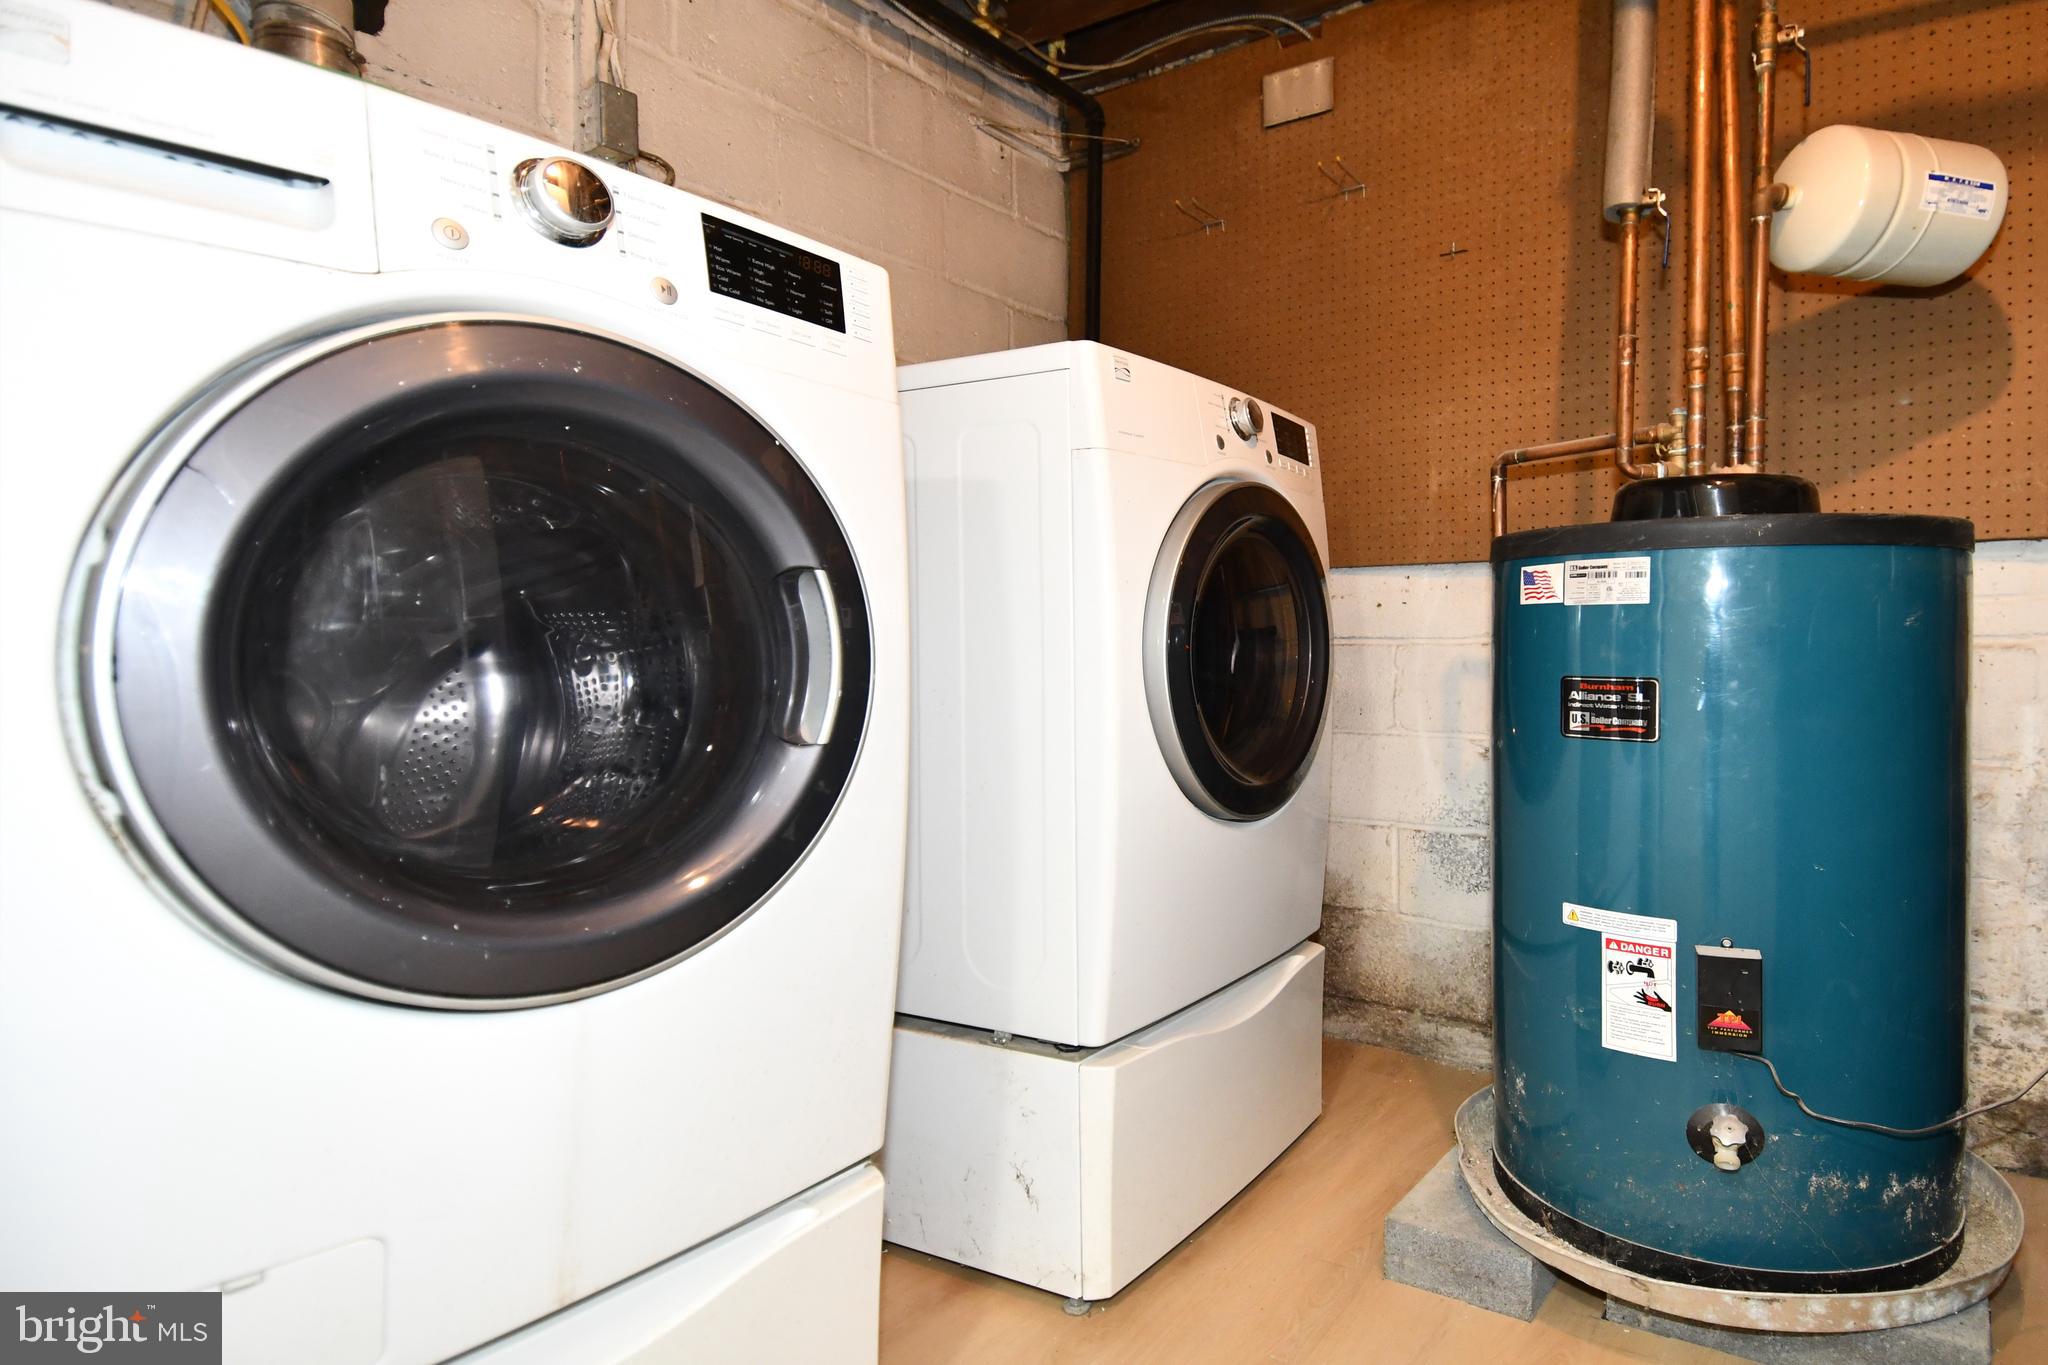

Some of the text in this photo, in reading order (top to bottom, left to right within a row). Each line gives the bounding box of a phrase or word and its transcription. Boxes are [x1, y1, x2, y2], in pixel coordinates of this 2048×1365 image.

[1580, 682, 1634, 691] Burnham
[1568, 690, 1622, 702] Alliance
[1571, 712, 1589, 724] U.S.
[1591, 716, 1612, 725] Boiler
[1612, 717, 1648, 727] Company
[1620, 942, 1669, 957] DANGER
[1711, 1030, 1748, 1038] IMMERSION
